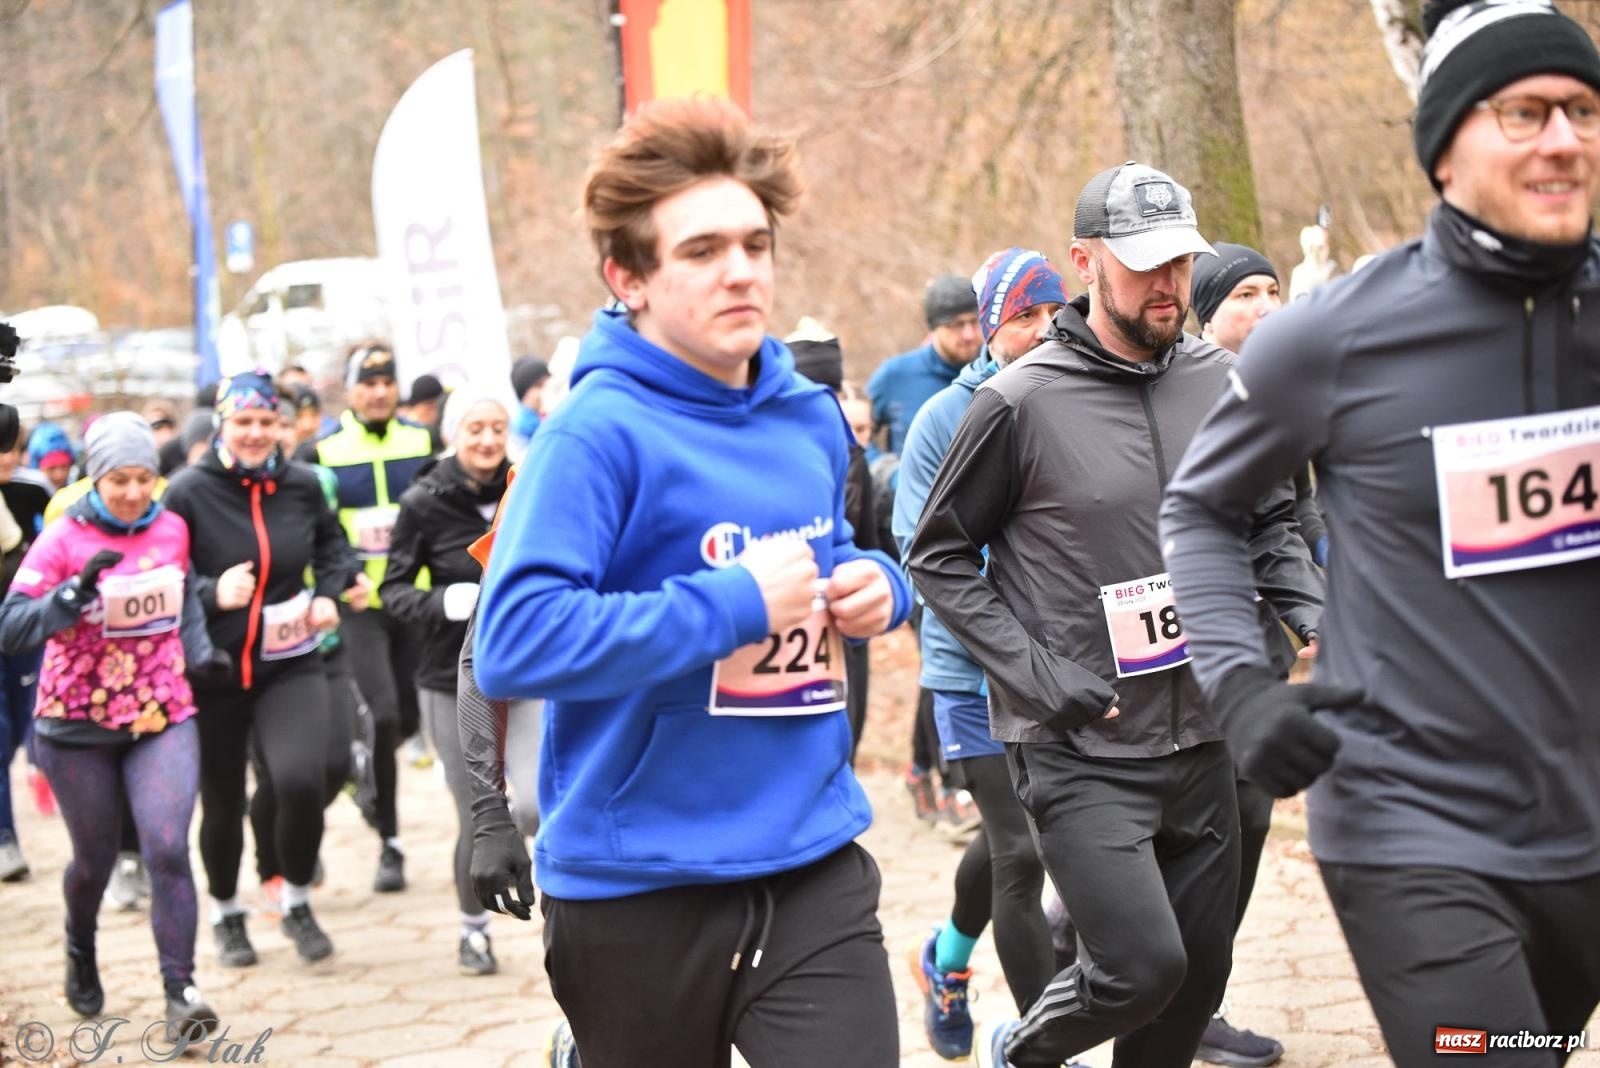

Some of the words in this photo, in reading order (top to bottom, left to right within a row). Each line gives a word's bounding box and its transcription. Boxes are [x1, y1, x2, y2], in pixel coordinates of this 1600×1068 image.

[1488, 461, 1600, 524] 164
[125, 592, 165, 618] 001
[1115, 584, 1145, 599] BIEG
[1139, 604, 1184, 645] 18
[752, 626, 831, 674] 224
